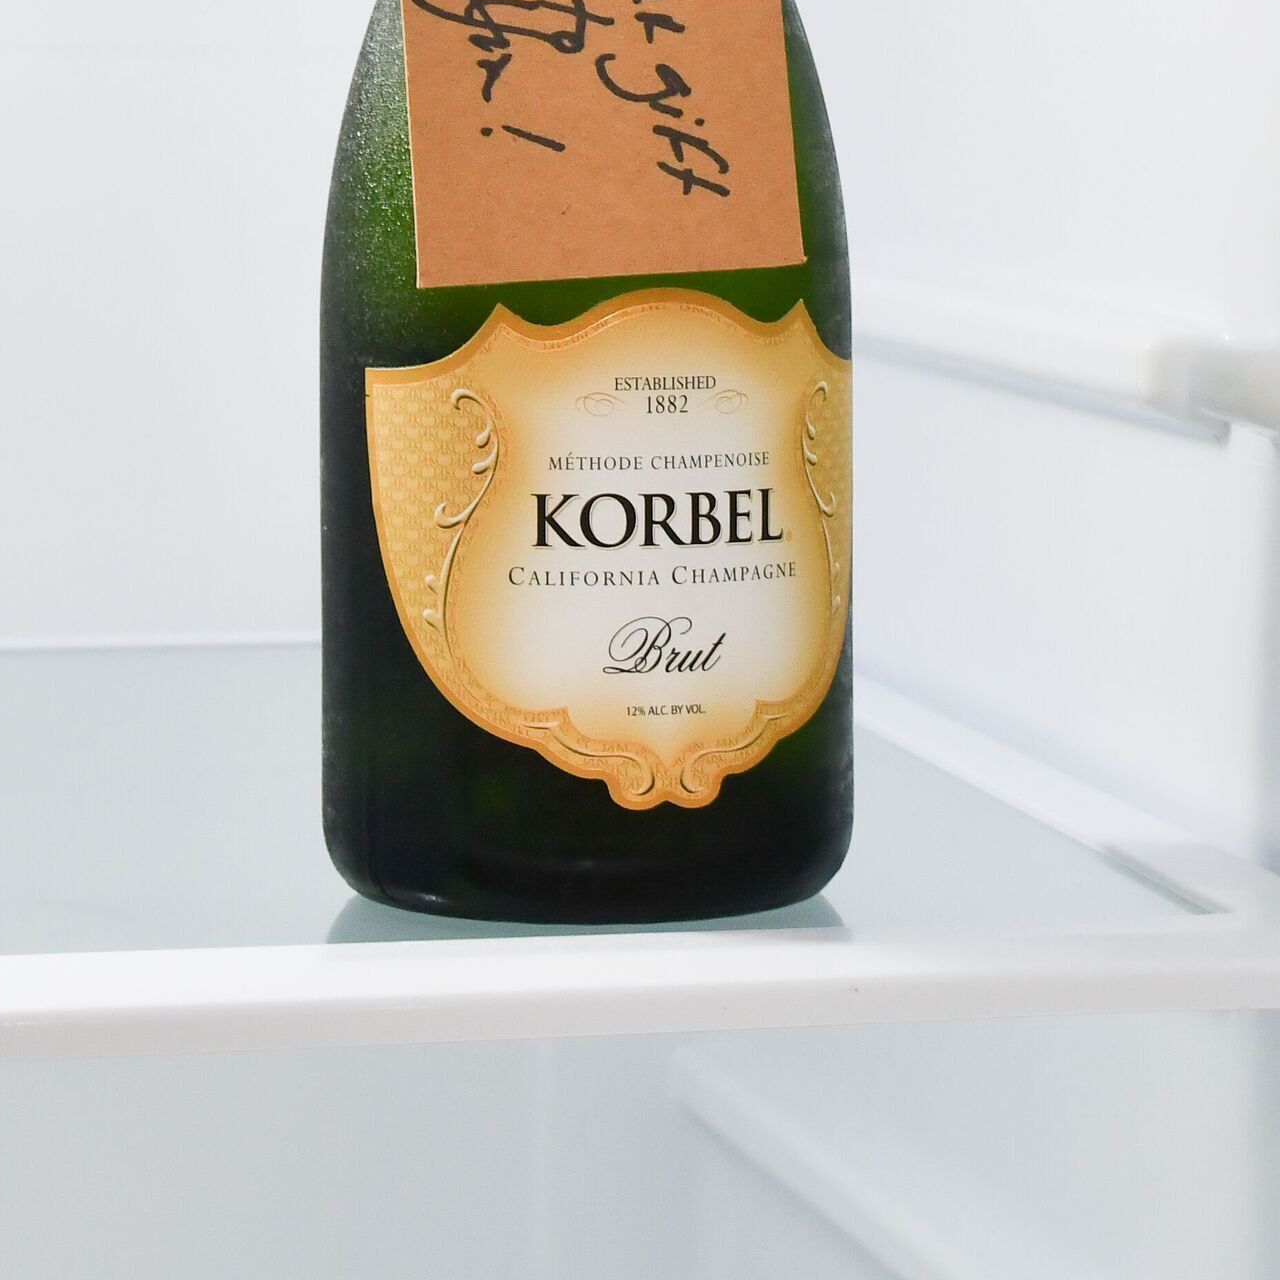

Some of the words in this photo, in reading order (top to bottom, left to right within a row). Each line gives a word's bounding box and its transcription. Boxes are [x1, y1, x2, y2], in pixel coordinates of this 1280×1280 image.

[595, 52, 731, 197] gift
[613, 375, 717, 392] ESTABLISHED
[645, 394, 689, 415] 1882
[548, 451, 644, 471] MÉTHODE
[650, 451, 771, 470] CHAMPENOISE
[530, 487, 784, 549] KORBEL
[508, 566, 661, 587] CALIFORNIA
[671, 561, 797, 586] CHAMPAGNE
[602, 615, 727, 675] Brut
[625, 705, 646, 717] 12%
[670, 704, 684, 715] BY
[685, 703, 707, 715] VOL.
